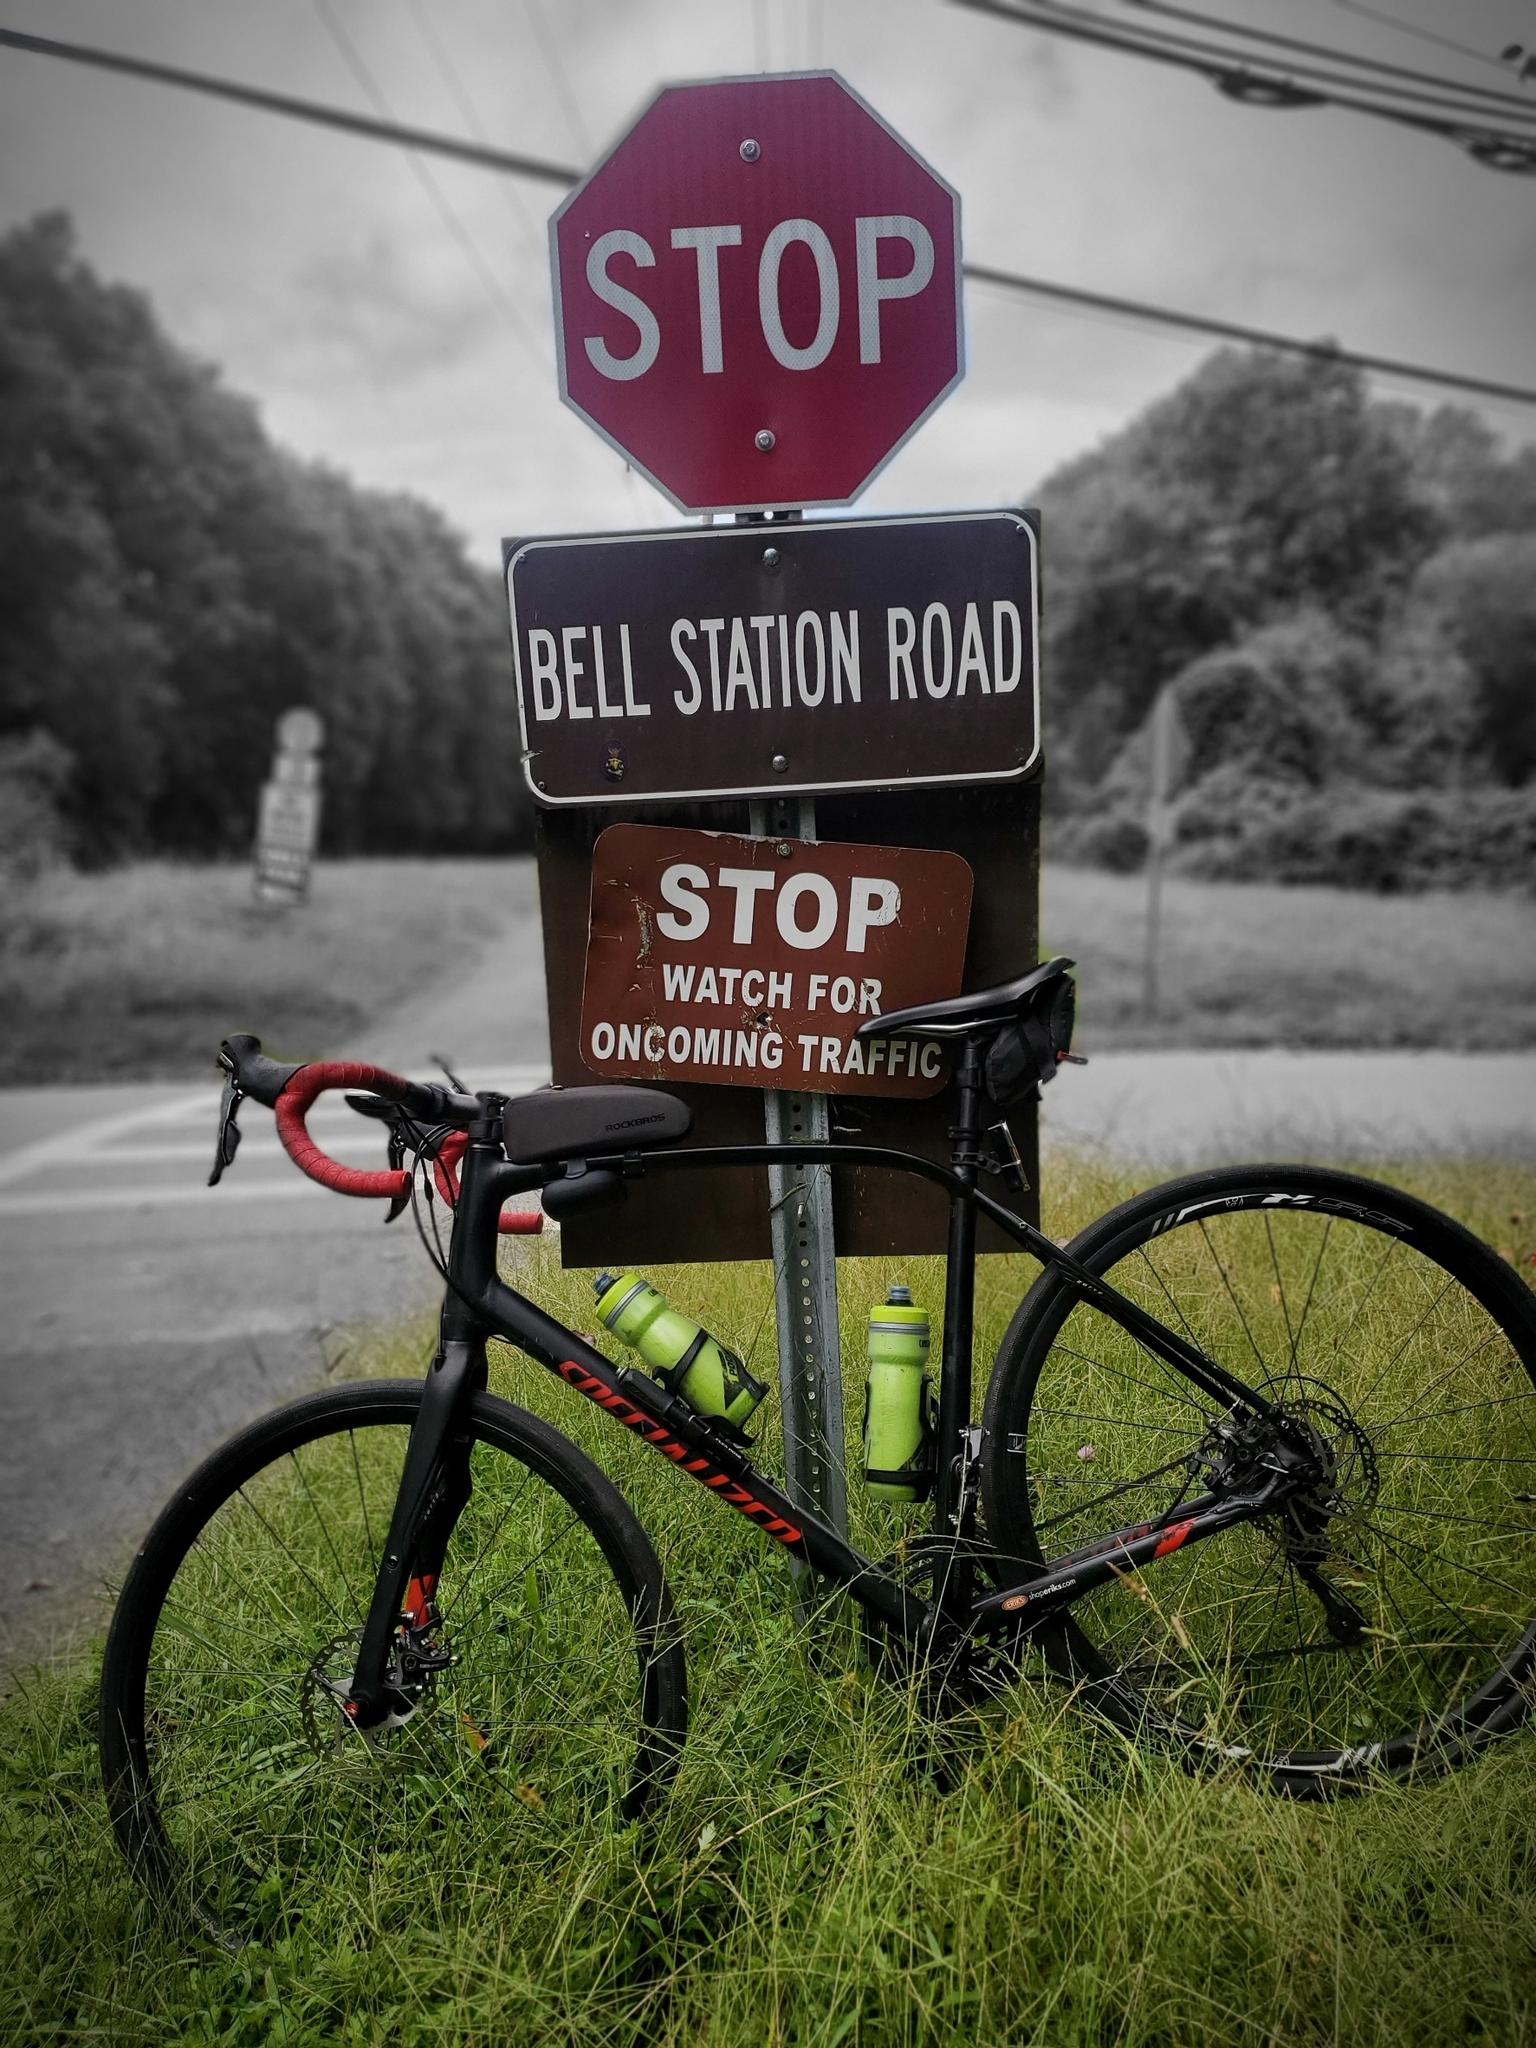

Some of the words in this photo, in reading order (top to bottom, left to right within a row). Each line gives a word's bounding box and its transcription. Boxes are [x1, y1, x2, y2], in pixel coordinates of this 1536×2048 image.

[584, 215, 935, 381] STOP
[528, 623, 652, 721] BELL
[670, 609, 862, 716] STATION
[887, 600, 1023, 701] ROAD
[656, 863, 901, 953] STOP
[662, 963, 793, 1010] WATCH
[807, 974, 882, 1016] FOR
[591, 1022, 783, 1070] ONCOMING
[798, 1034, 942, 1079] TRAFFIC
[604, 1112, 666, 1132] ROCKBROS
[559, 1360, 802, 1543] SPECIALIZED
[1028, 1578, 1076, 1601] shoperiks.com
